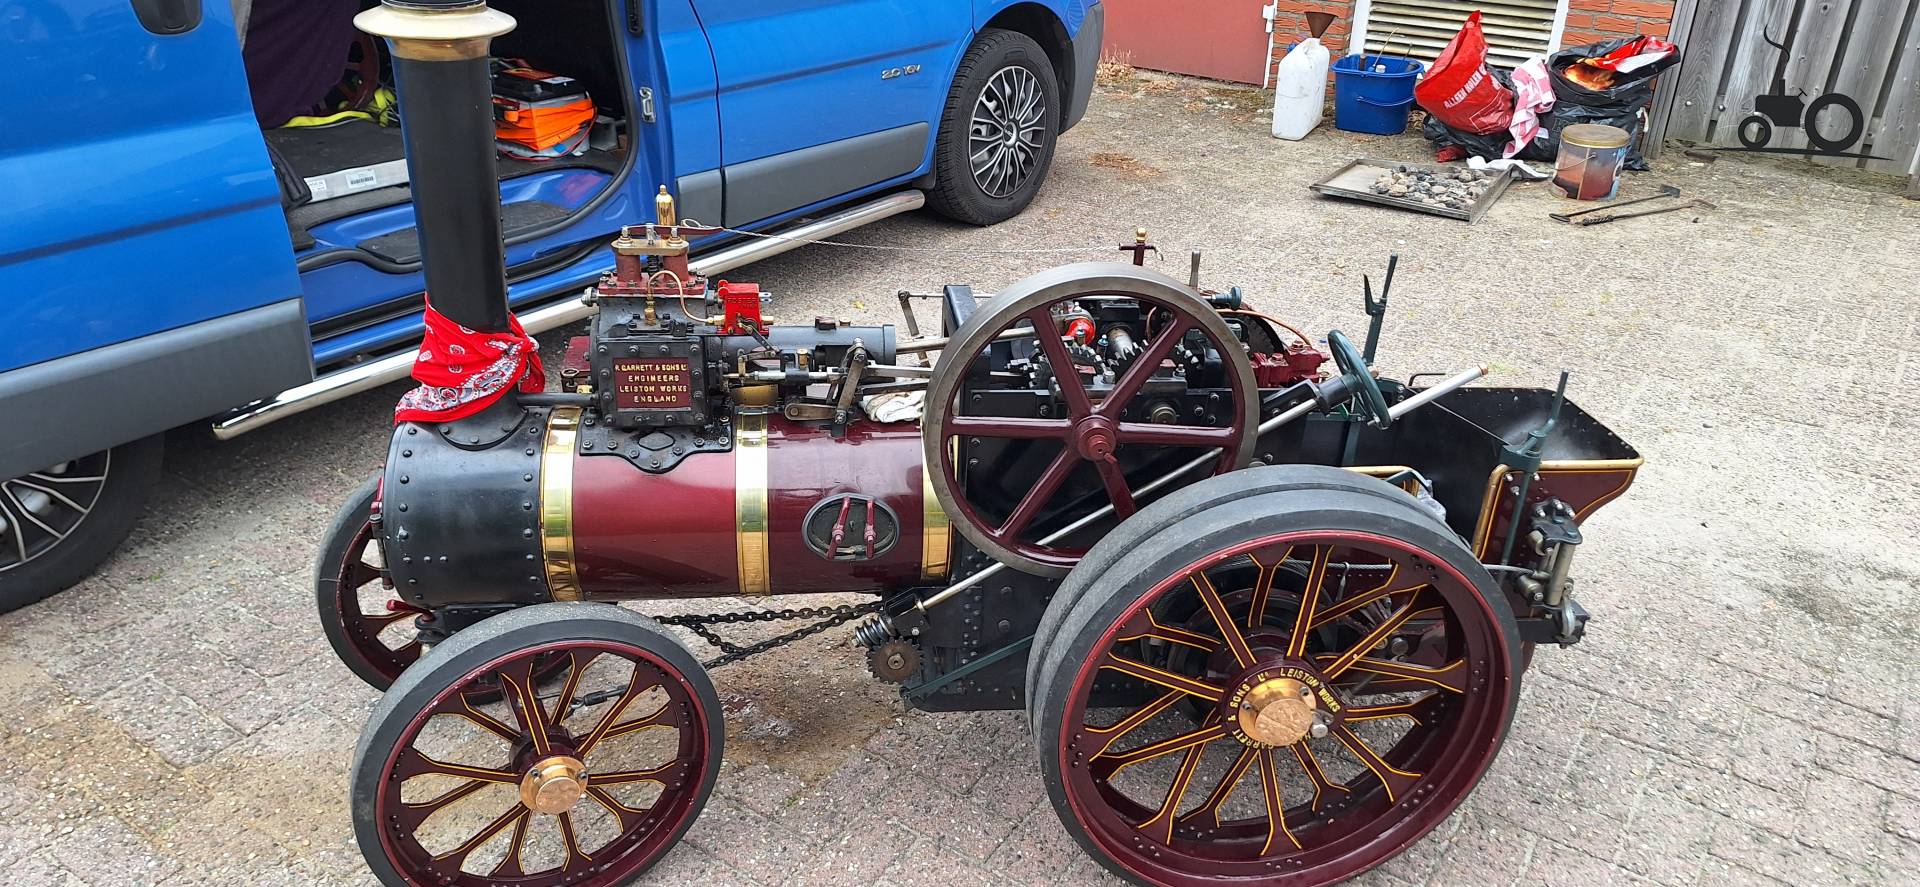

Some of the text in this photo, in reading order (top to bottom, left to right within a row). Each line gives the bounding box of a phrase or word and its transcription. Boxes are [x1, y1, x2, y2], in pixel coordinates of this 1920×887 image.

[620, 385, 655, 393] LEISTON
[634, 395, 677, 403] ENGLAND
[1229, 683, 1250, 708] SONS
[1279, 667, 1320, 687] LEISTON
[1318, 687, 1341, 713] WORKS
